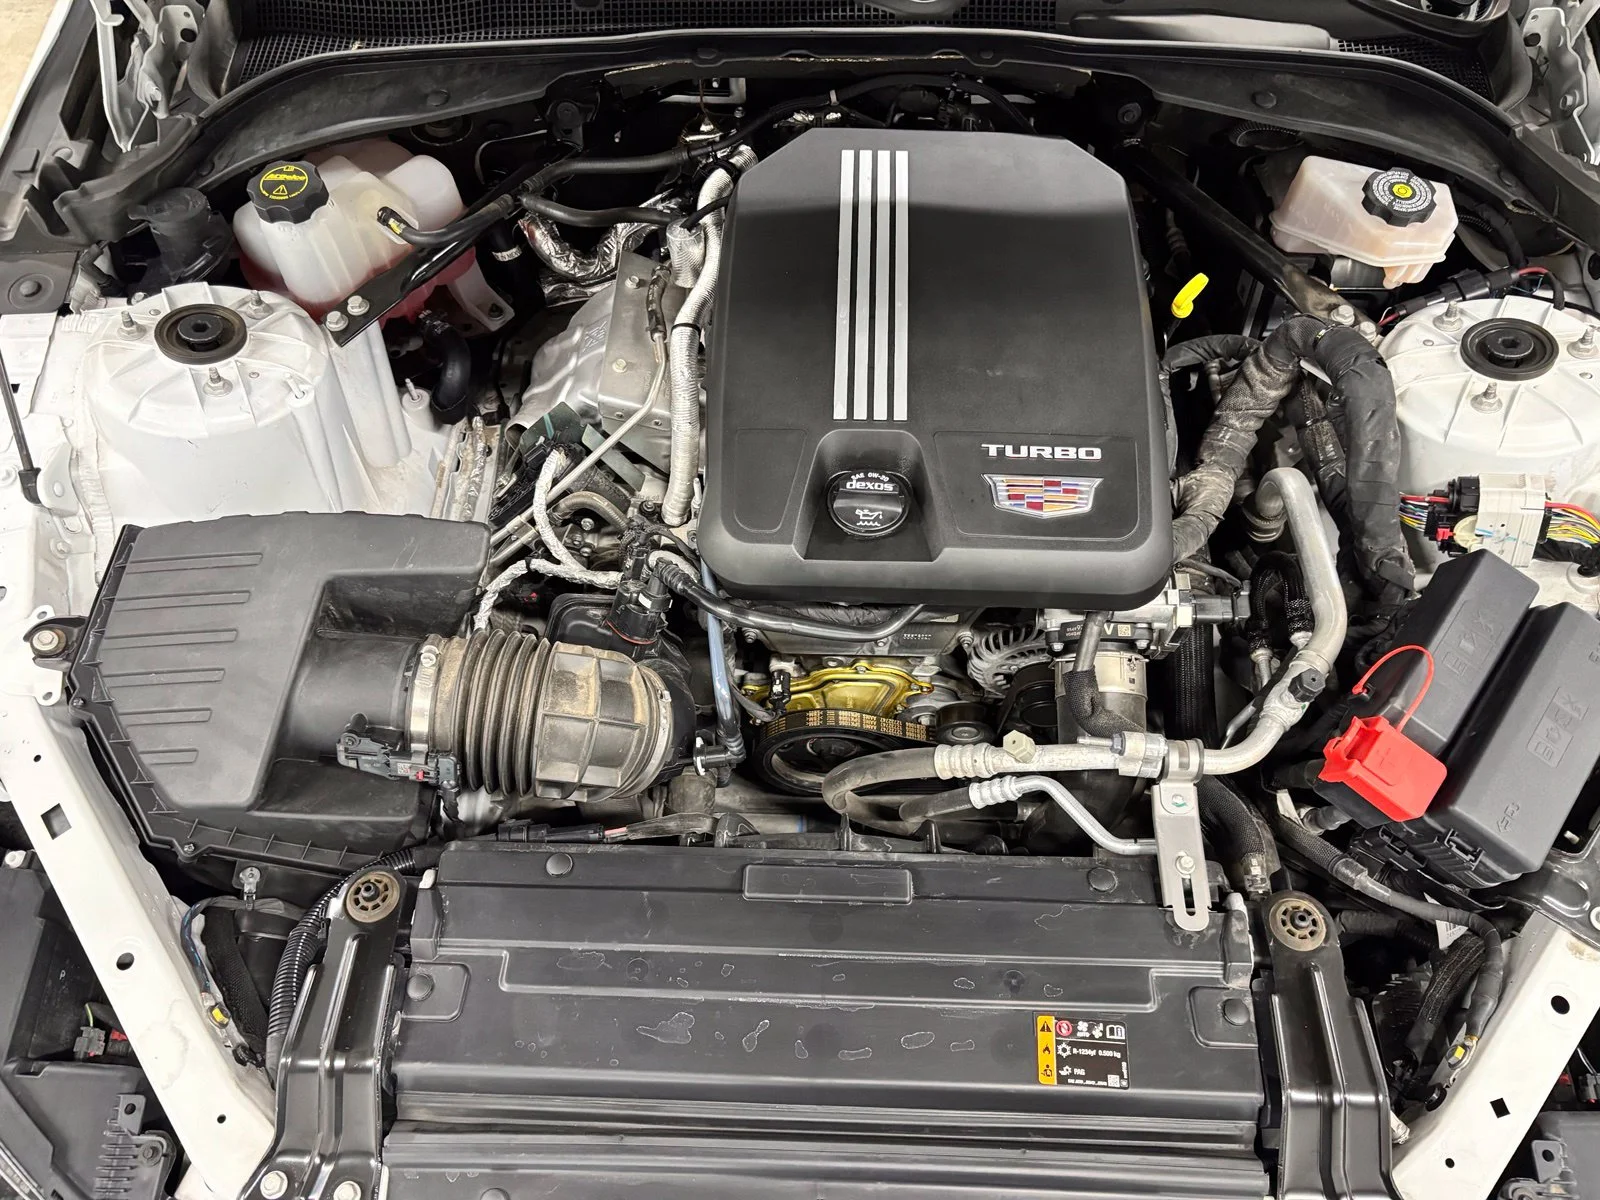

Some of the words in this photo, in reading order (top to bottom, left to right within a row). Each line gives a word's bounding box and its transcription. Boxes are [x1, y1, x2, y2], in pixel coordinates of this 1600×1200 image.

[981, 443, 1102, 460] TURBO
[850, 472, 865, 481] SAE
[867, 472, 890, 482] 0W-20
[846, 479, 894, 491] dexos
[1072, 1048, 1096, 1057] R-1234yf
